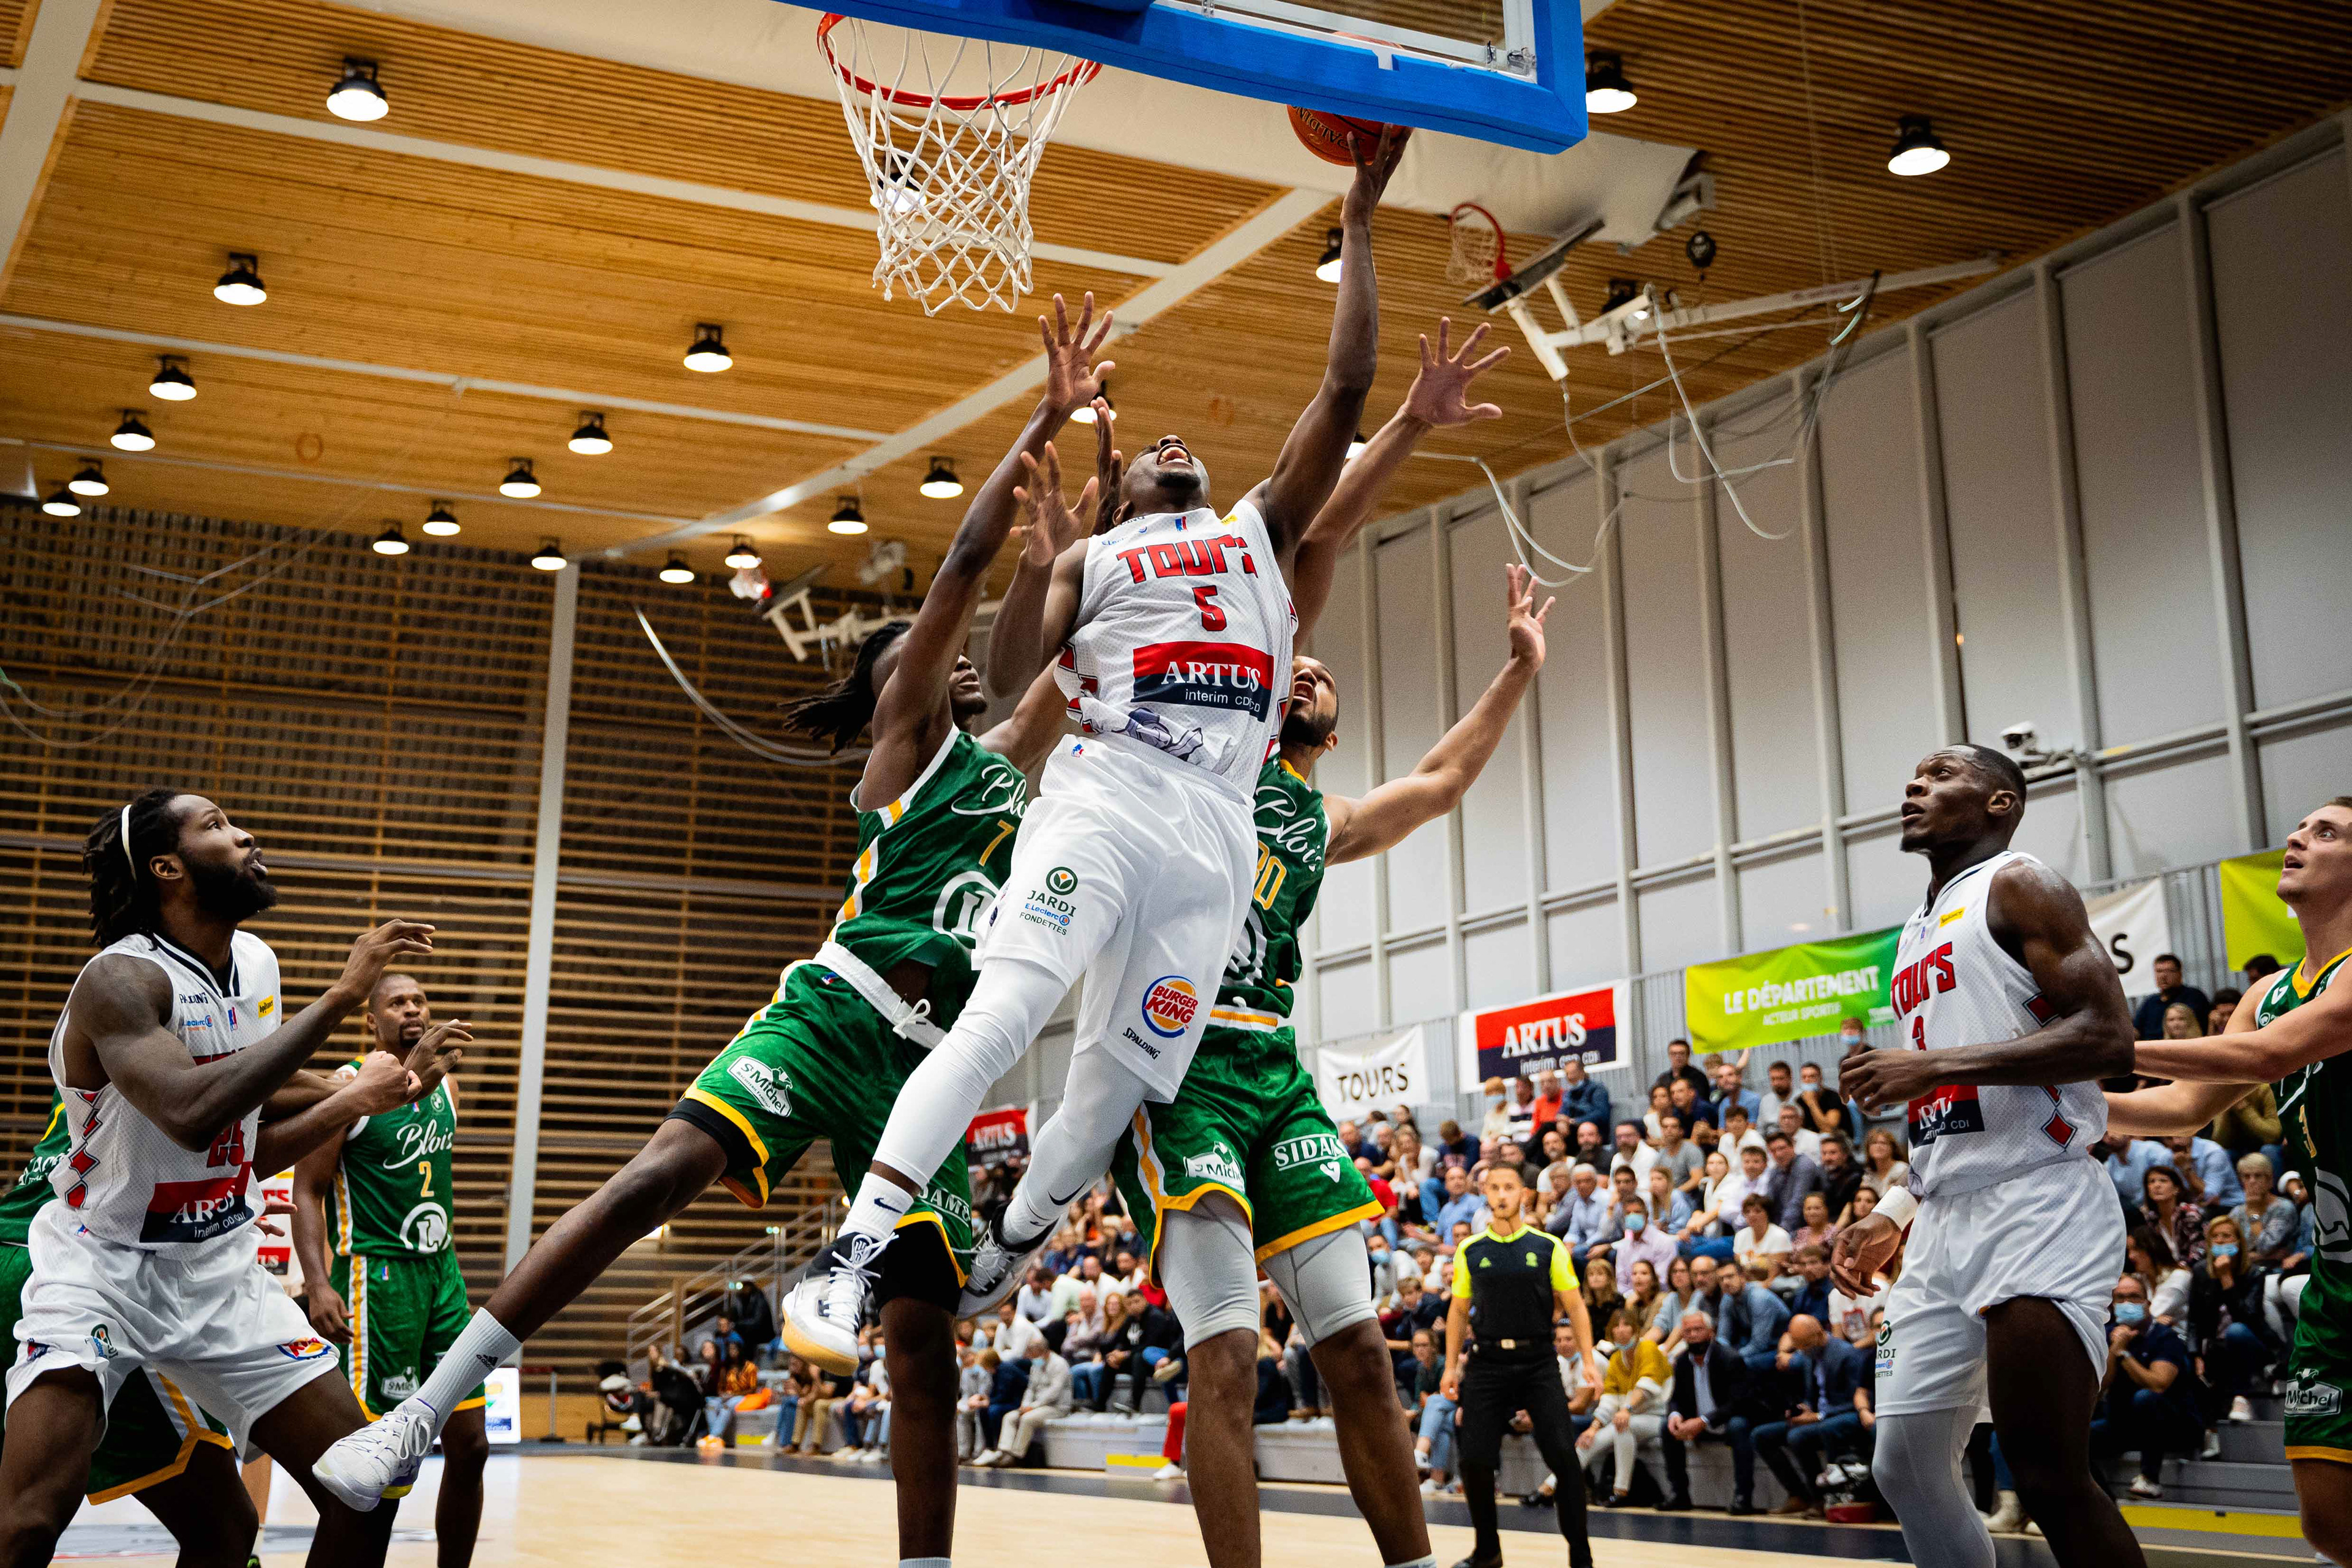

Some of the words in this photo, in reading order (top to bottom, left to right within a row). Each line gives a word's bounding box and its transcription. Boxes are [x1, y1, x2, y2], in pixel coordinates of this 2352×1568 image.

[1192, 585, 1227, 631] 5
[1161, 661, 1261, 692] ARTUS
[1185, 689, 1228, 704] interim
[951, 764, 1028, 818] Blo
[978, 820, 1014, 867] 7
[1025, 903, 1059, 920] E.Leclerc
[1027, 890, 1076, 918] JARDI
[1019, 912, 1067, 935] FONDETTES
[1724, 990, 1744, 1014] LE
[1747, 966, 1880, 1011] DÉPARTEMENT
[1891, 941, 1956, 1021] TOURS
[1144, 996, 1194, 1023] KING
[1152, 985, 1198, 1011] BURGER
[1123, 1027, 1161, 1060] SPALDING
[1502, 1013, 1587, 1059] ARTUS
[749, 1071, 786, 1114] Michel
[1337, 1063, 1408, 1102] TOURS
[1951, 1120, 1970, 1129] CDI
[383, 1119, 453, 1170] Blois
[418, 1161, 435, 1197] 2
[1206, 1164, 1241, 1180] Mich
[1878, 1349, 1896, 1359] RDI
